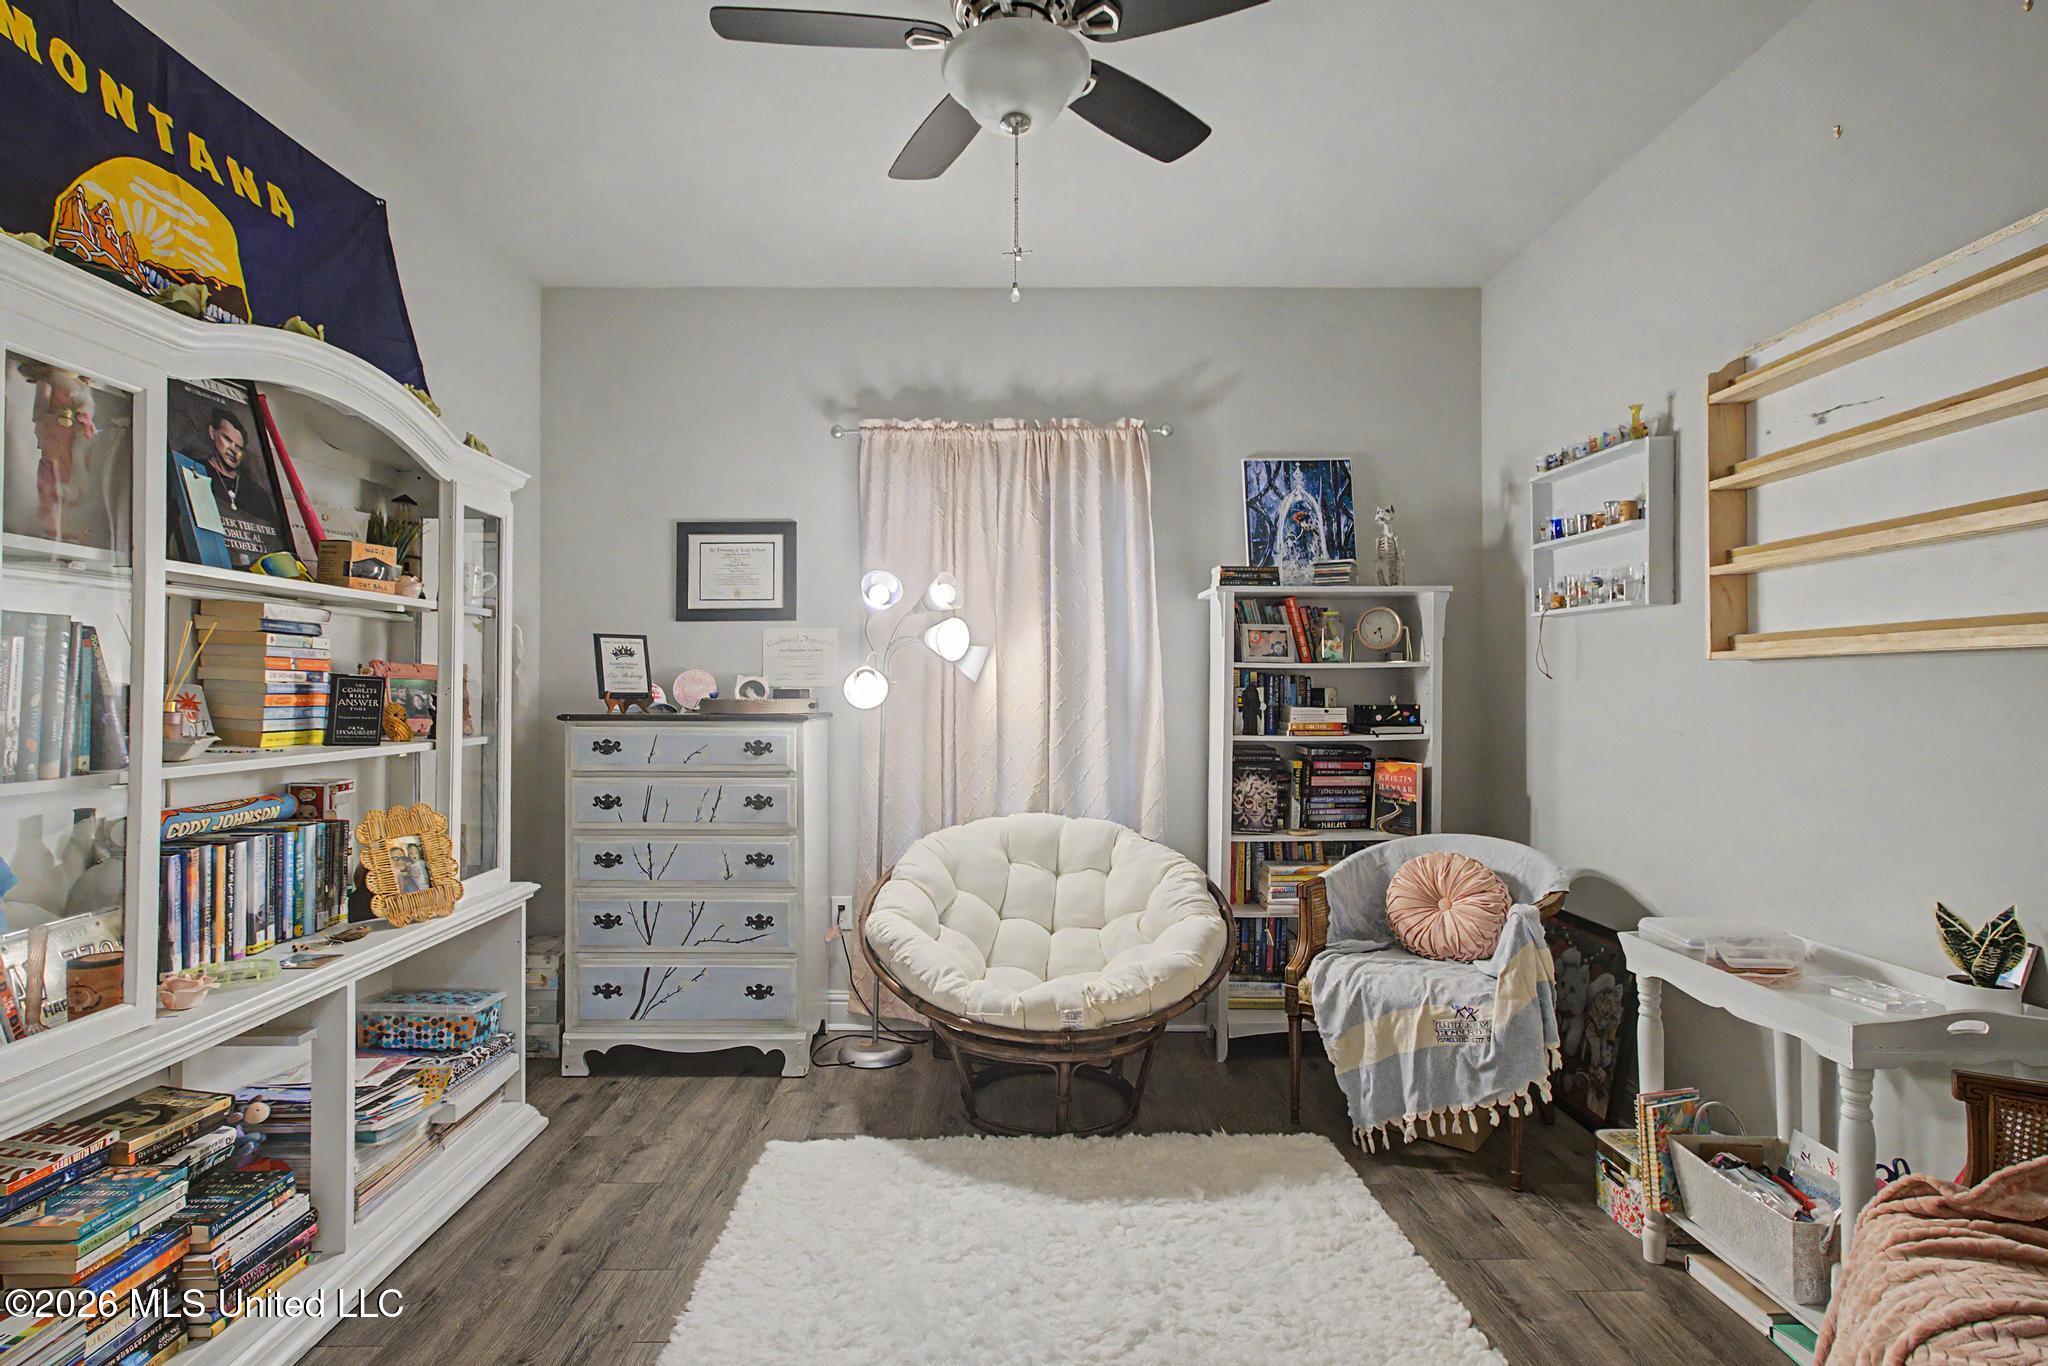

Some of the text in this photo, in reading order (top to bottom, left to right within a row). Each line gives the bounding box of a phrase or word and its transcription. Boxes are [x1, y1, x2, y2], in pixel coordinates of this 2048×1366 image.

[0, 0, 296, 229] MONTANA
[238, 520, 276, 536] THEATRE
[338, 699, 379, 707] ANSWER
[1378, 774, 1413, 784] KRISTIN
[166, 805, 281, 840] CODY JOHNSON
